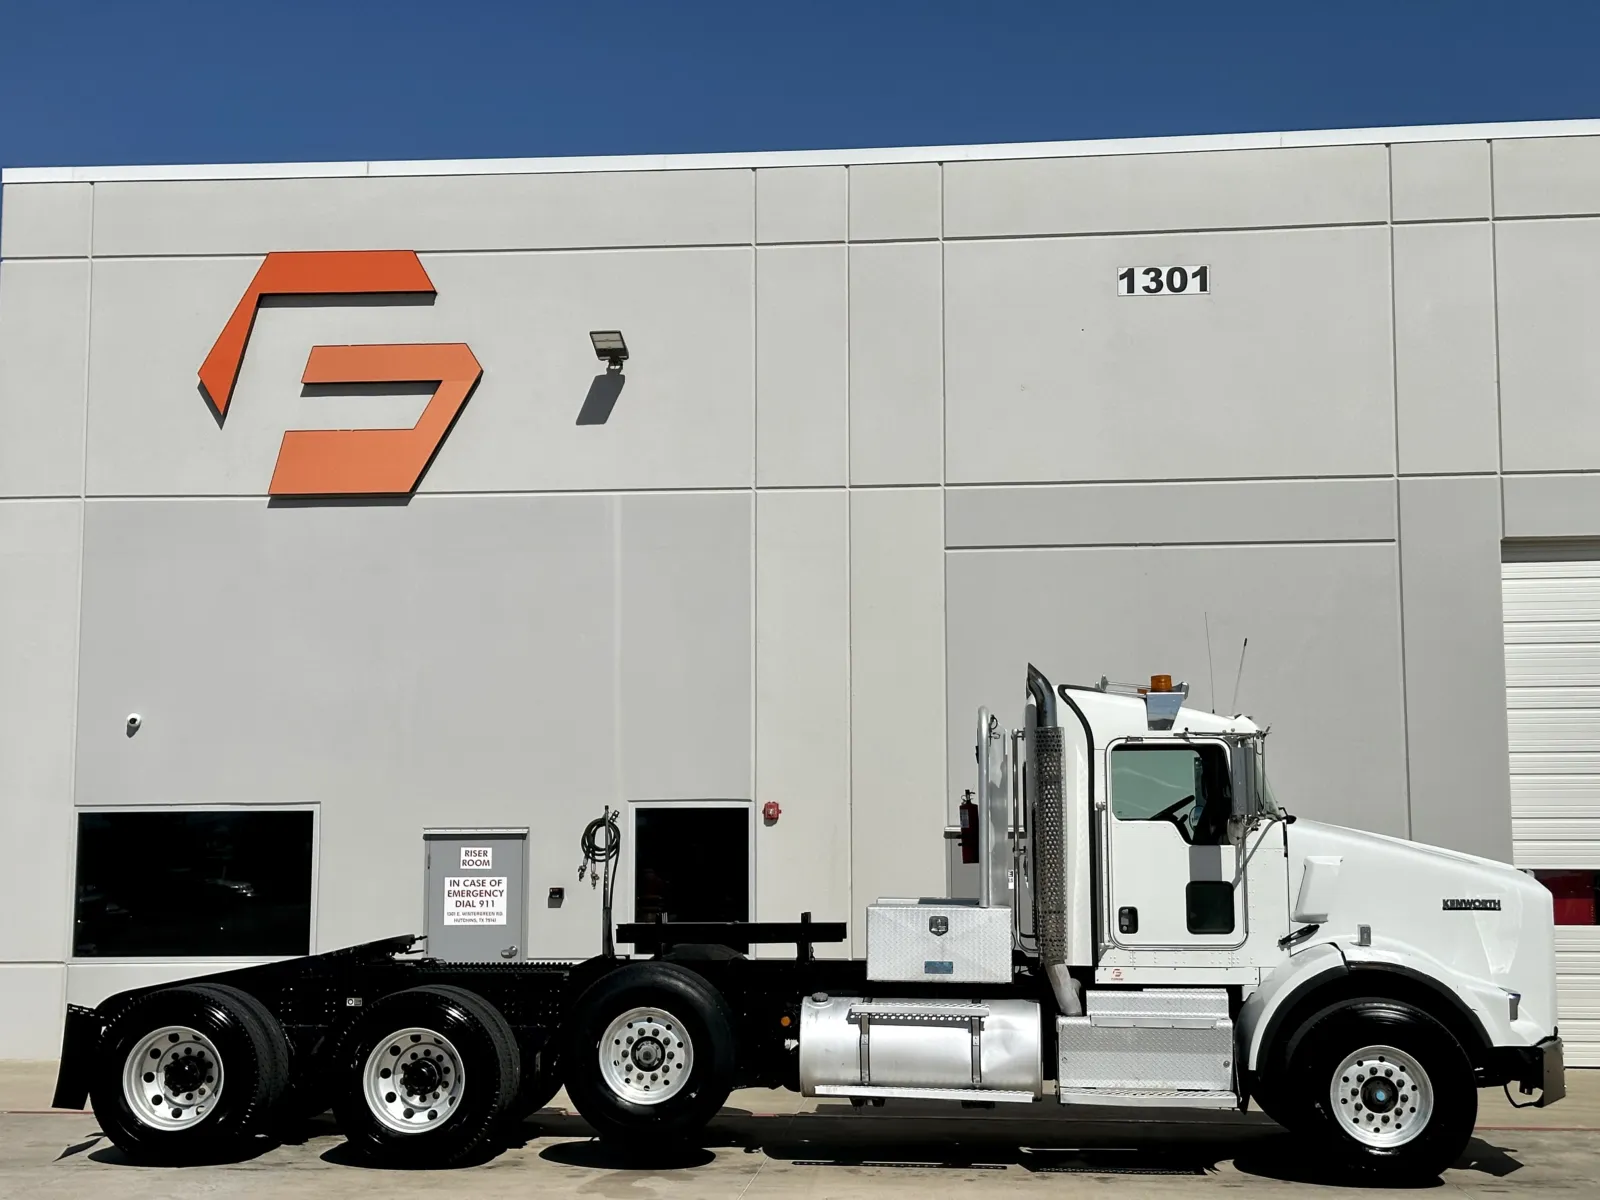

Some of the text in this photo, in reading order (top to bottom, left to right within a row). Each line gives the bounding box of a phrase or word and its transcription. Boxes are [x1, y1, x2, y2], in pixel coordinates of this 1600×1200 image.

[1119, 266, 1208, 294] 1301
[464, 849, 488, 857] RISER
[462, 859, 490, 867] ROOM
[449, 879, 503, 887] IN CASE OF
[447, 889, 505, 898] EMERGENCY
[455, 900, 495, 908] DIAL 911
[1442, 899, 1501, 910] KENWORTH
